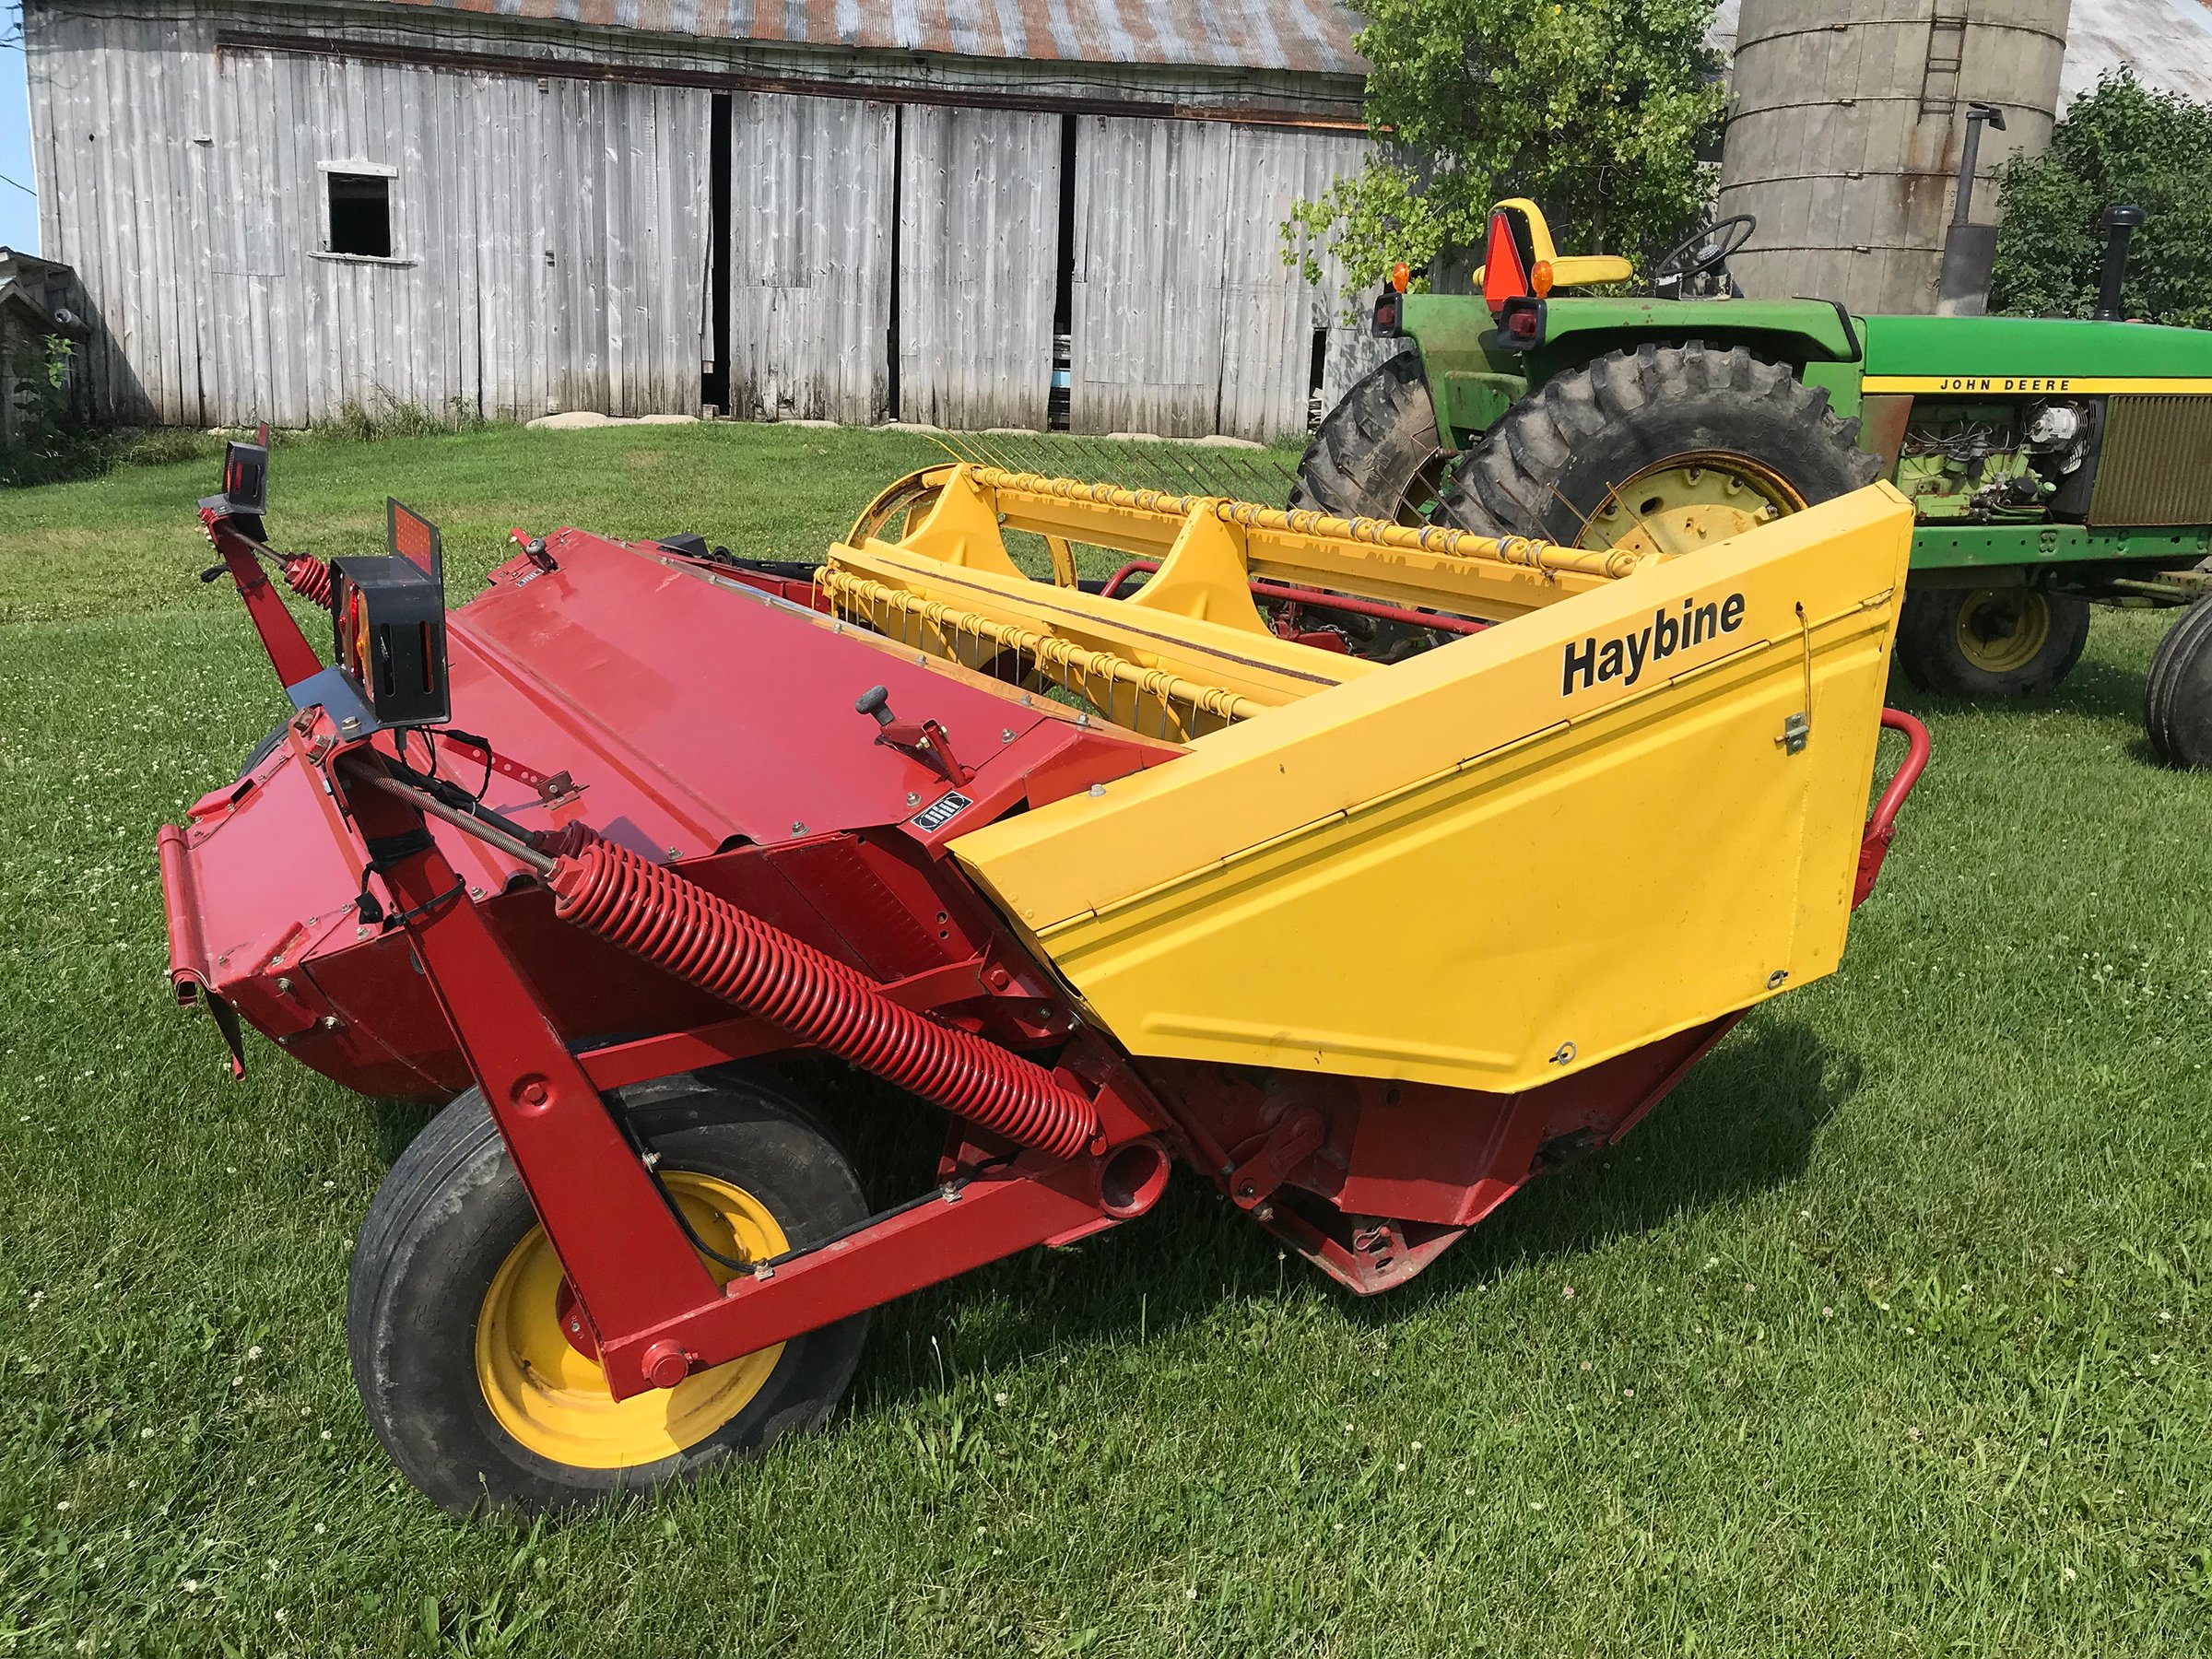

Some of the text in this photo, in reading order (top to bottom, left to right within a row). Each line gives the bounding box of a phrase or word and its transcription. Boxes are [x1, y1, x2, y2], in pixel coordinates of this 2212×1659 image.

[1940, 379, 2070, 391] JOHN DEERE
[1561, 592, 1746, 697] Haybine
